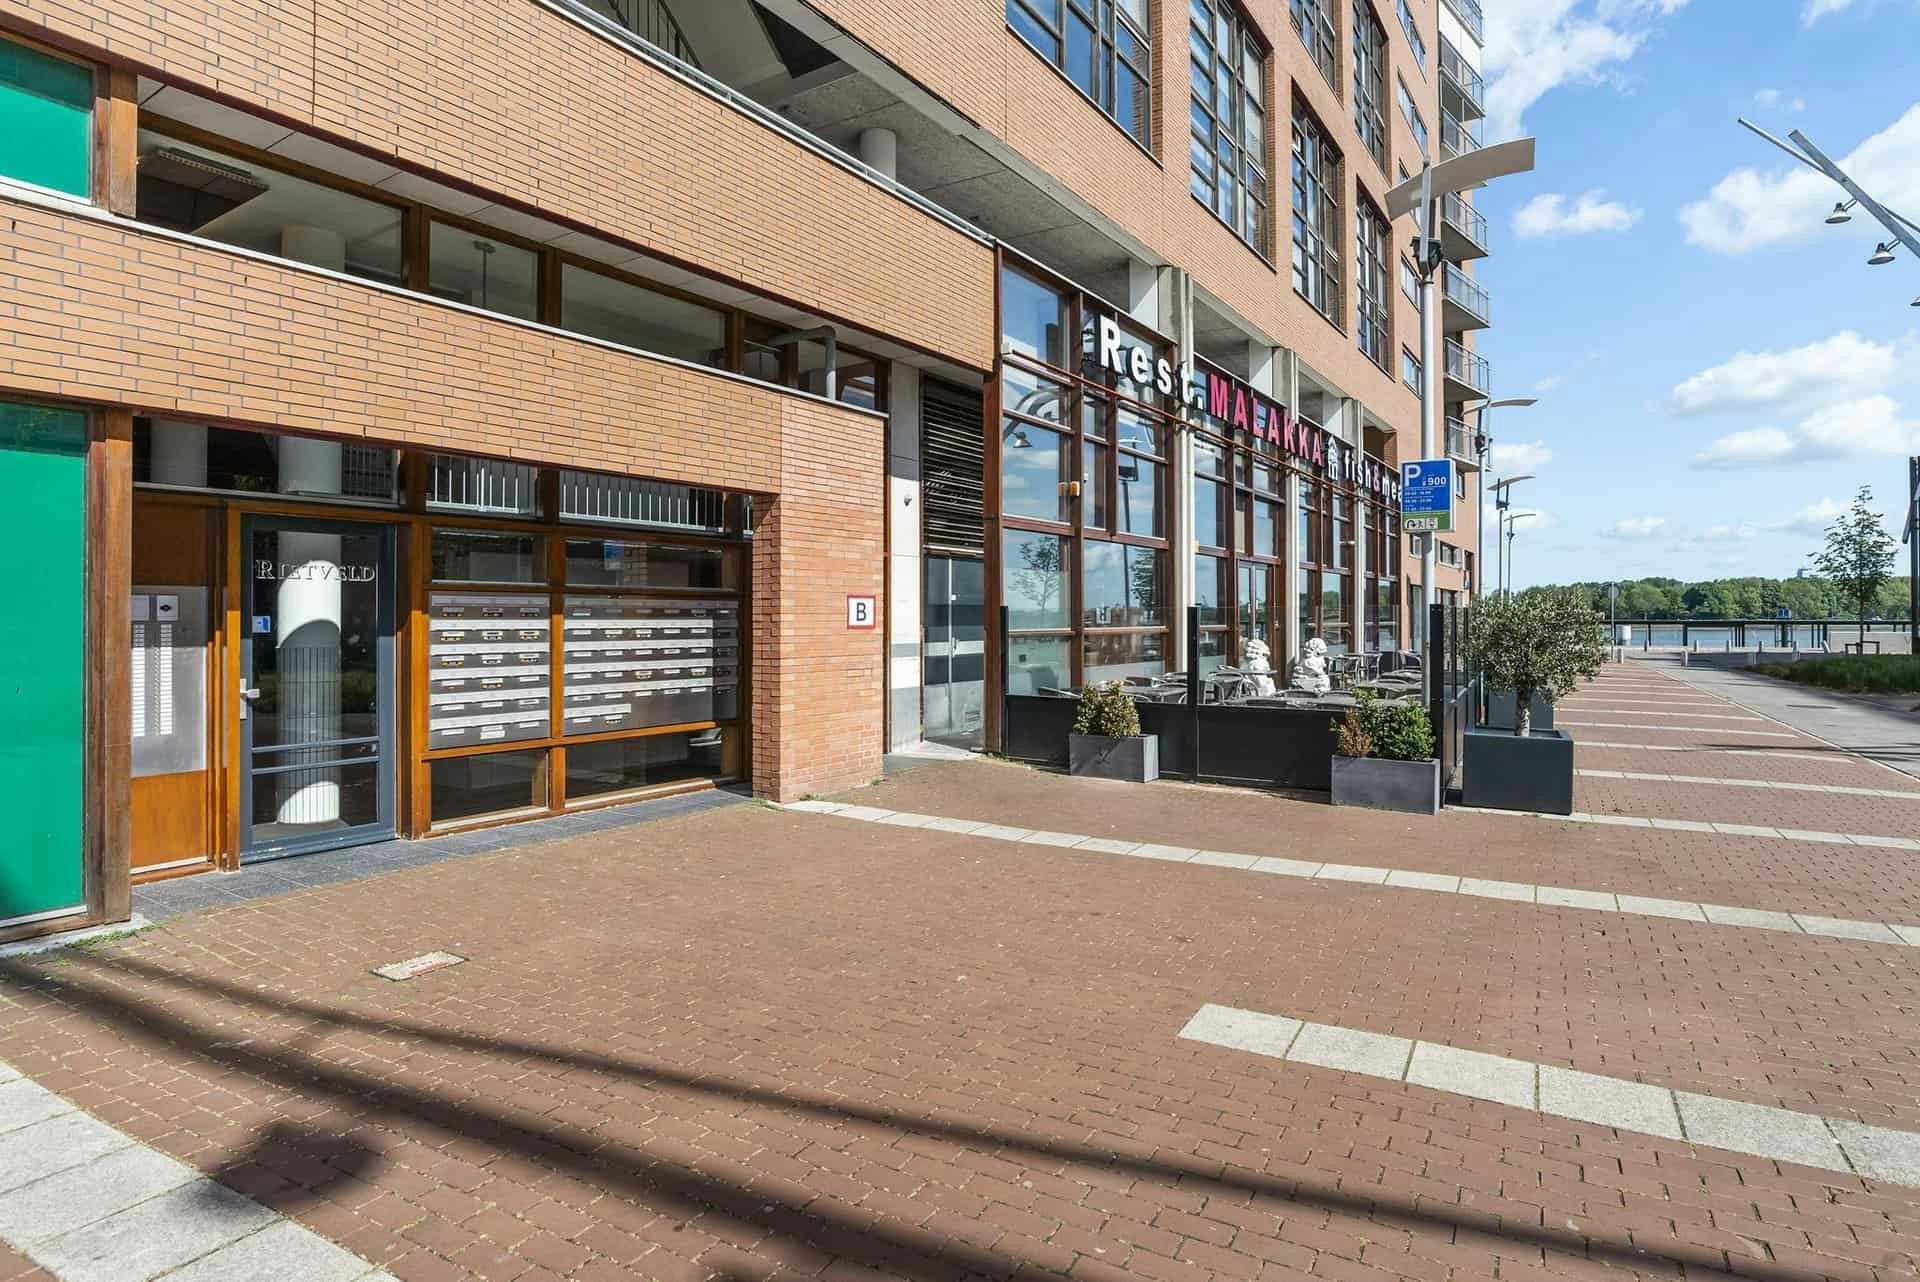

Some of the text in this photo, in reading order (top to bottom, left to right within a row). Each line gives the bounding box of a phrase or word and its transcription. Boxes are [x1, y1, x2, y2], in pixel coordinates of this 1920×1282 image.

[1099, 315, 1205, 410] Rest.
[1209, 374, 1323, 465] MALAKKA
[1404, 464, 1421, 487] P
[1427, 476, 1447, 486] 900
[256, 560, 376, 582] RIETVELD
[856, 602, 867, 621] B
